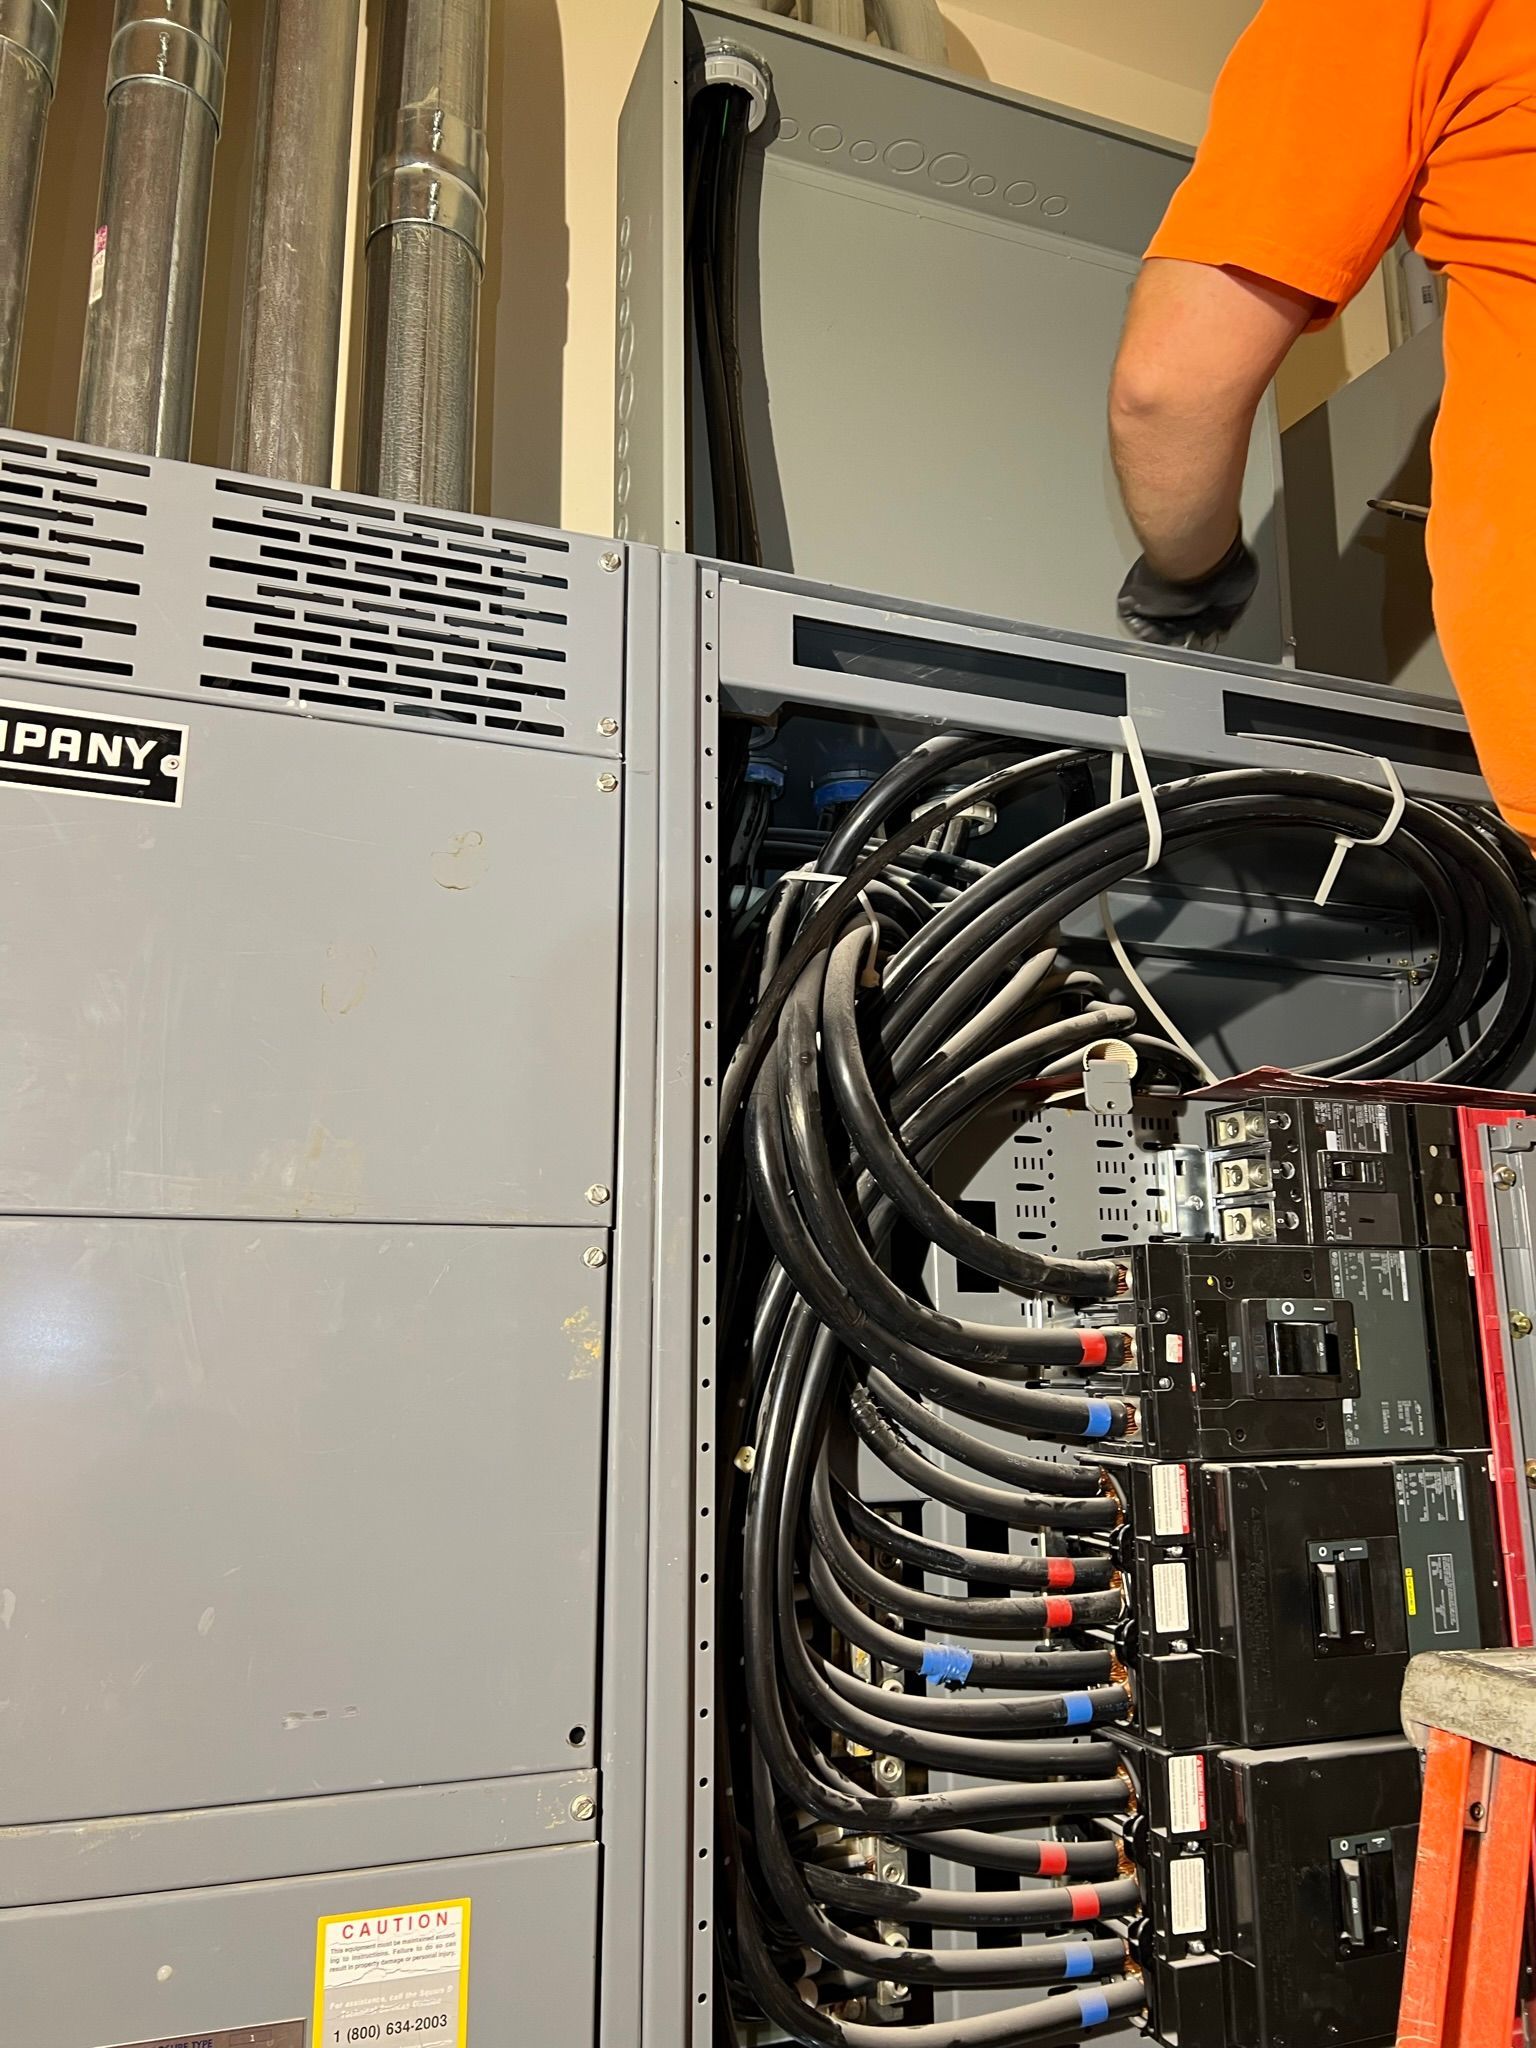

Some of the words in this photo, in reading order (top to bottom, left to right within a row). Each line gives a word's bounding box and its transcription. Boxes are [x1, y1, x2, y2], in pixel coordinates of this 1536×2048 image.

[0, 719, 158, 770] PANY
[342, 1911, 448, 1940] CAUTION
[345, 1943, 376, 1953] equipment
[334, 2030, 340, 2043] 1
[346, 2024, 381, 2044] (800)
[386, 2014, 448, 2036] 634-2003
